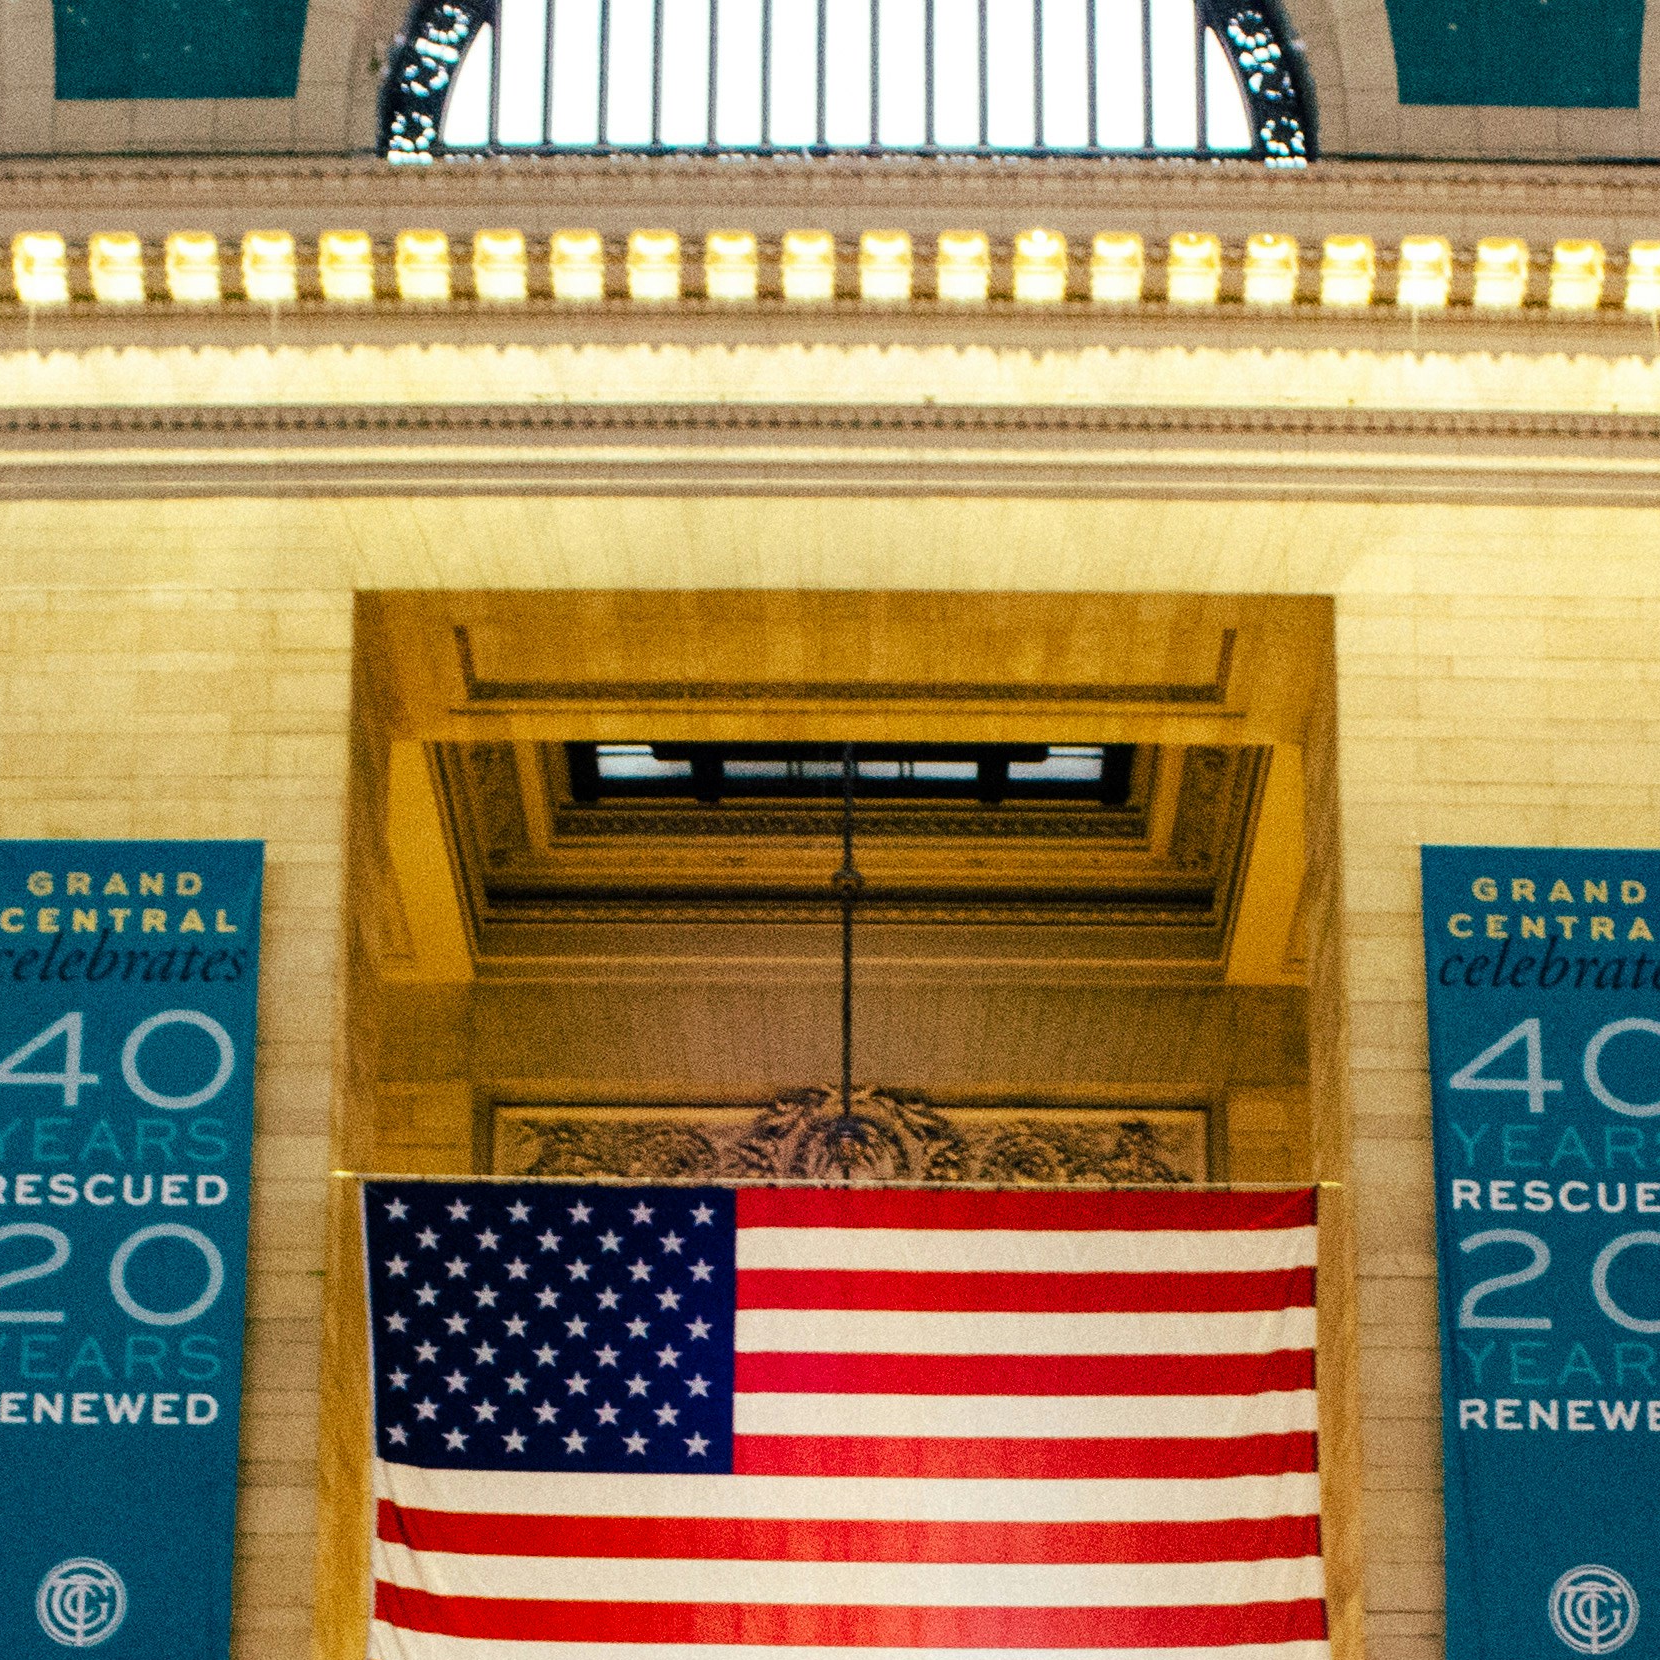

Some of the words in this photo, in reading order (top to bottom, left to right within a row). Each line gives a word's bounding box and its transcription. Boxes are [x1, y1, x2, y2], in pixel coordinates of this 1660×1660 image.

[27, 871, 204, 897] GRAND
[1471, 877, 1648, 905] GRAND
[0, 907, 239, 934] CENTRAL
